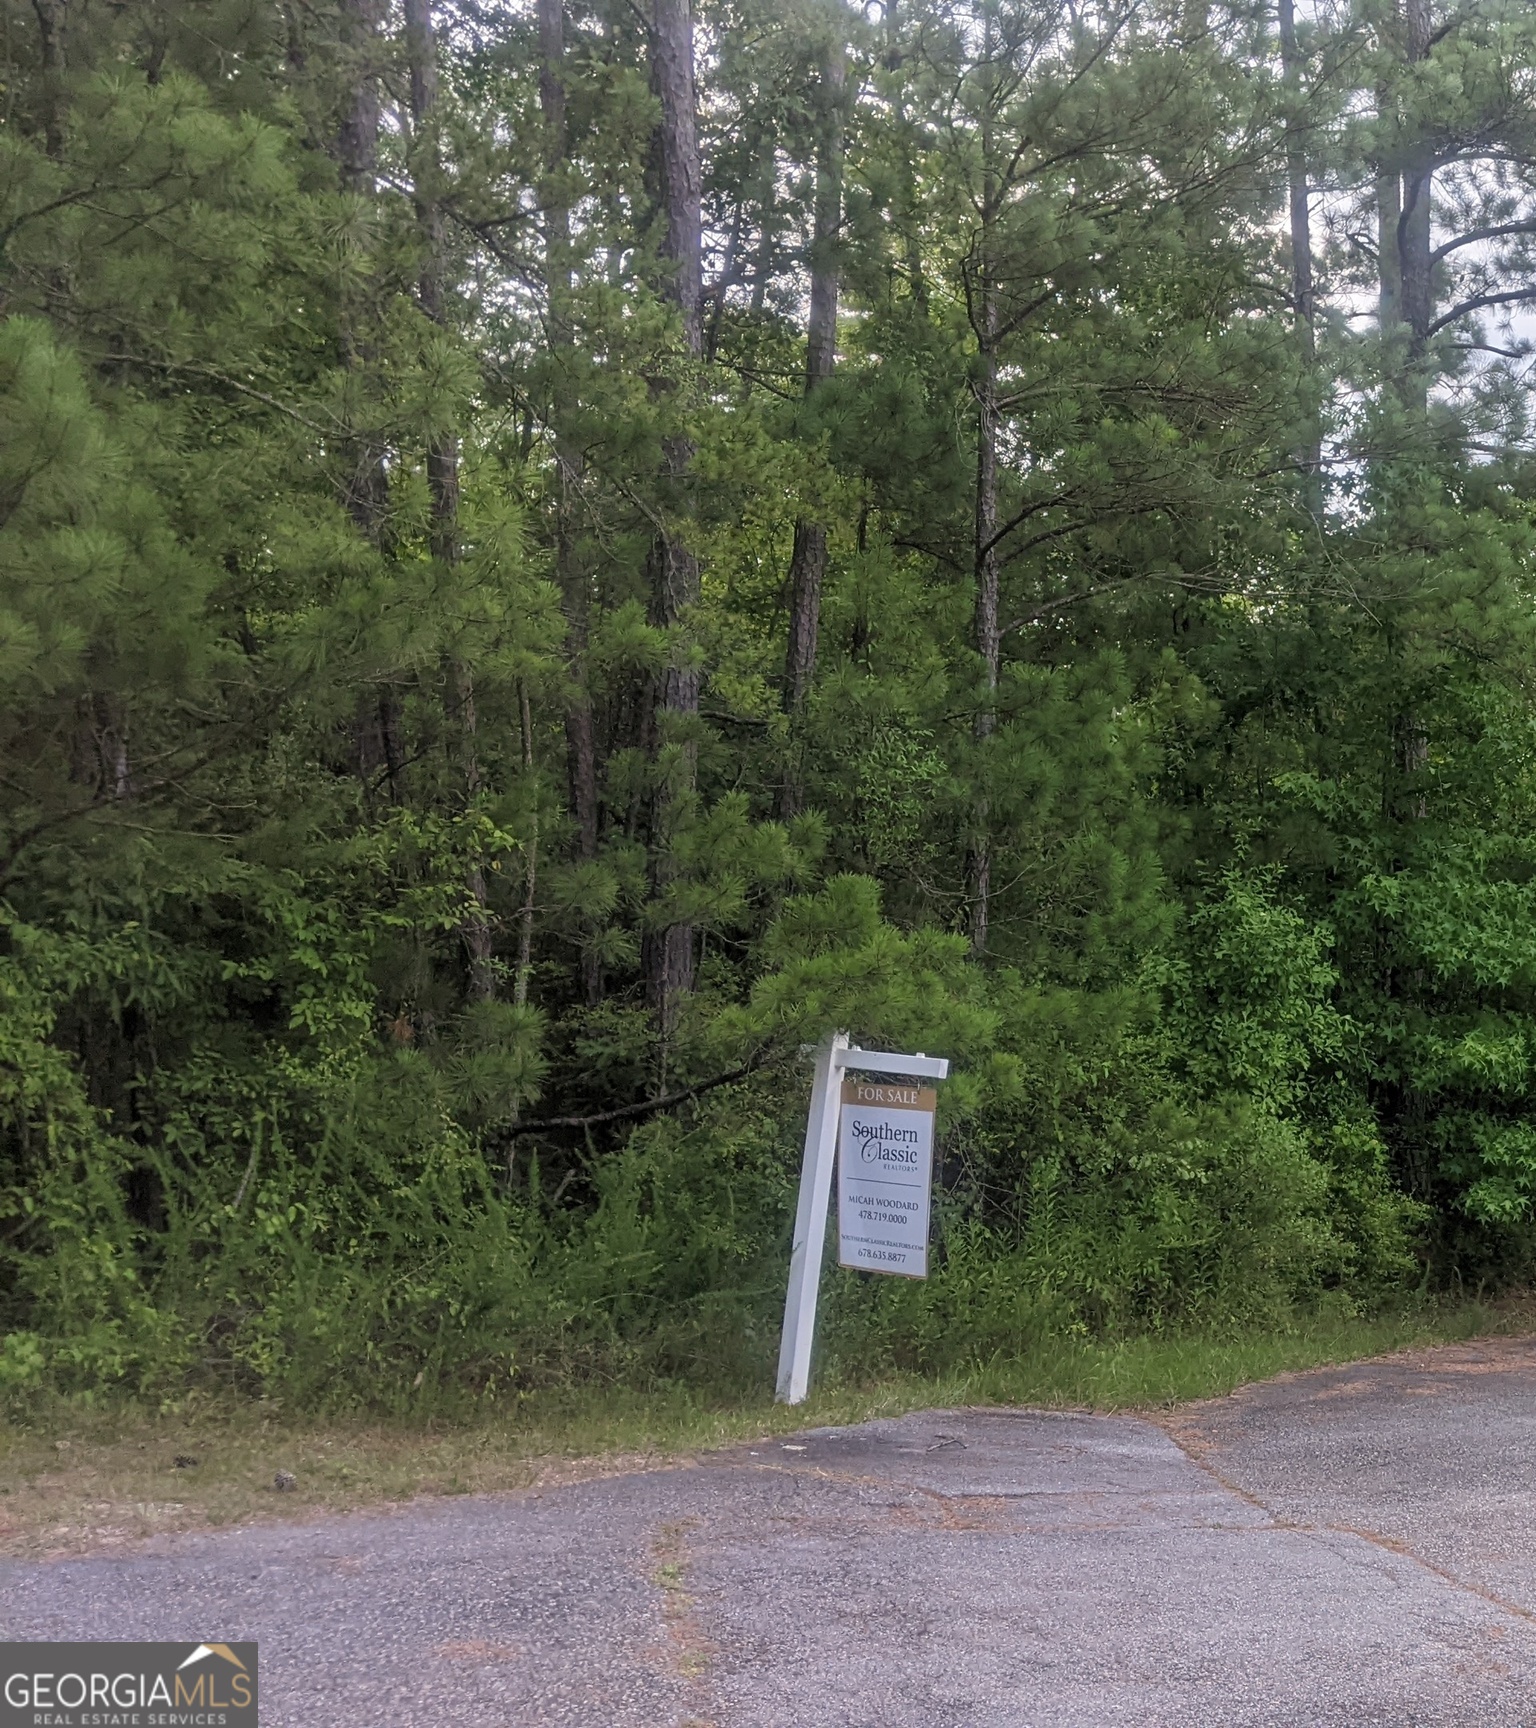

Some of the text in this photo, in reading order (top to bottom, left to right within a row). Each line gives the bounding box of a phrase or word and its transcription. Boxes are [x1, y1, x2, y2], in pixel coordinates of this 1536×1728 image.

[857, 1086, 918, 1104] FOR SALE
[852, 1119, 918, 1143] Southern
[857, 1137, 918, 1164] Classic
[848, 1195, 919, 1211] MICAH WOODARD
[858, 1209, 908, 1225] 478.719.0000
[857, 1248, 907, 1263] 678.635.8877
